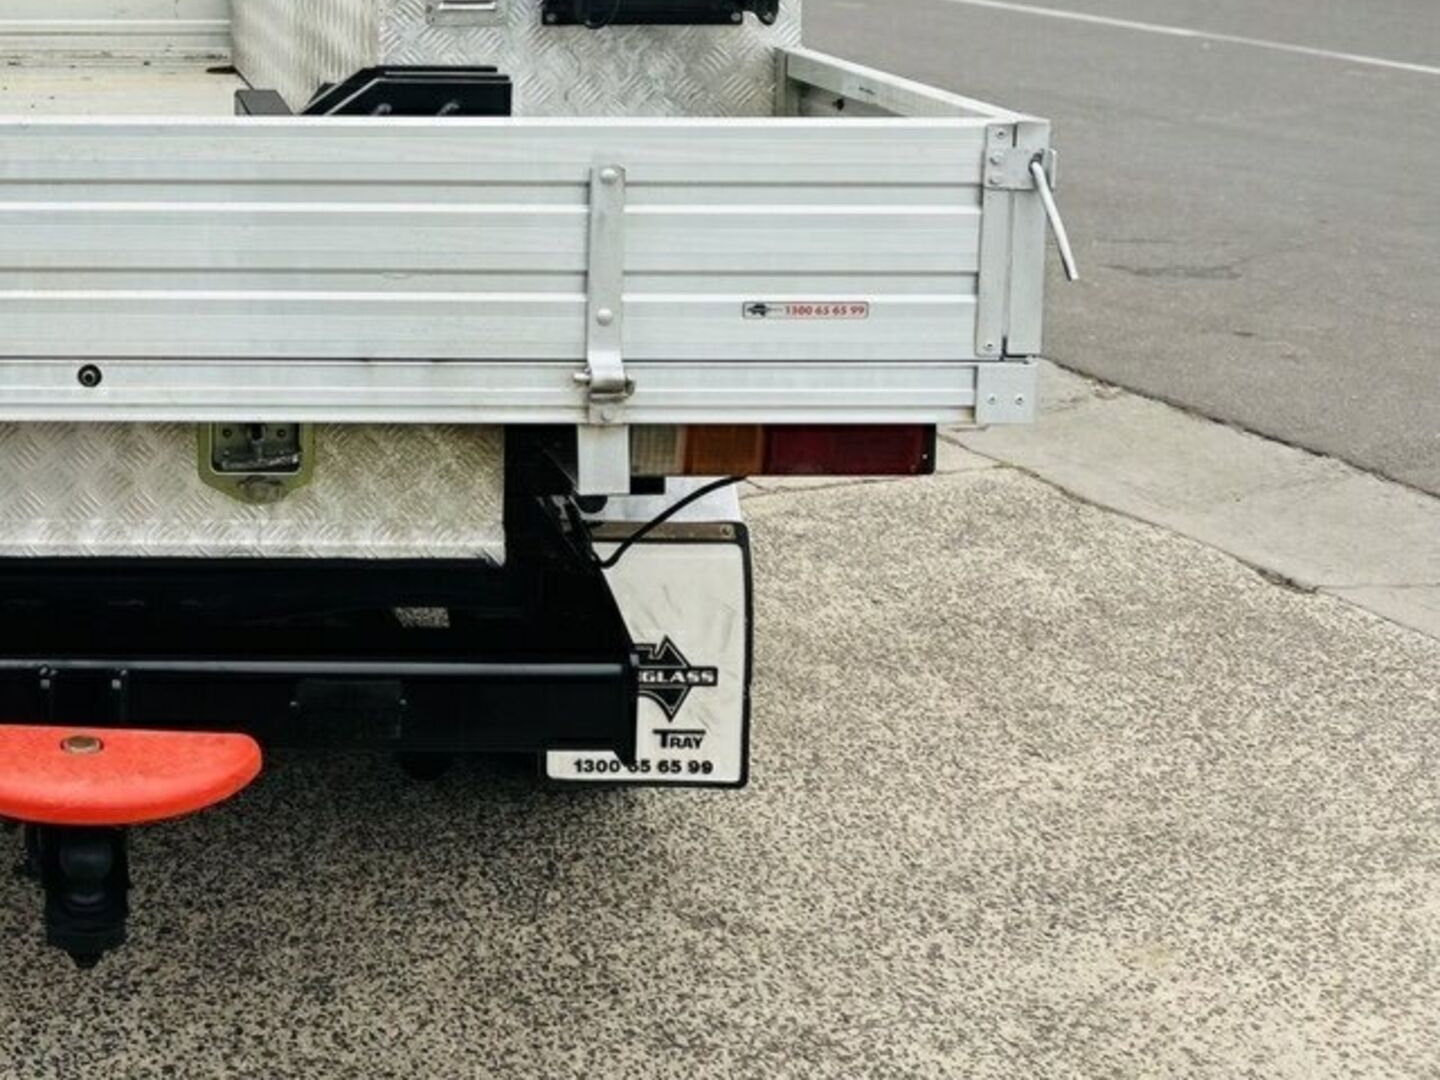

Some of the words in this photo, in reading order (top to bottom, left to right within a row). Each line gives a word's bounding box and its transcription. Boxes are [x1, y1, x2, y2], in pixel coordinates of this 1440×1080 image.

[785, 305, 813, 316] 1300
[814, 305, 830, 316] 65
[832, 305, 847, 316] 65
[850, 305, 866, 316] 99
[640, 670, 715, 684] GLASS
[652, 729, 706, 750] TRAY
[573, 759, 621, 775] 1300
[656, 760, 682, 775] 65
[688, 760, 714, 776] 99
